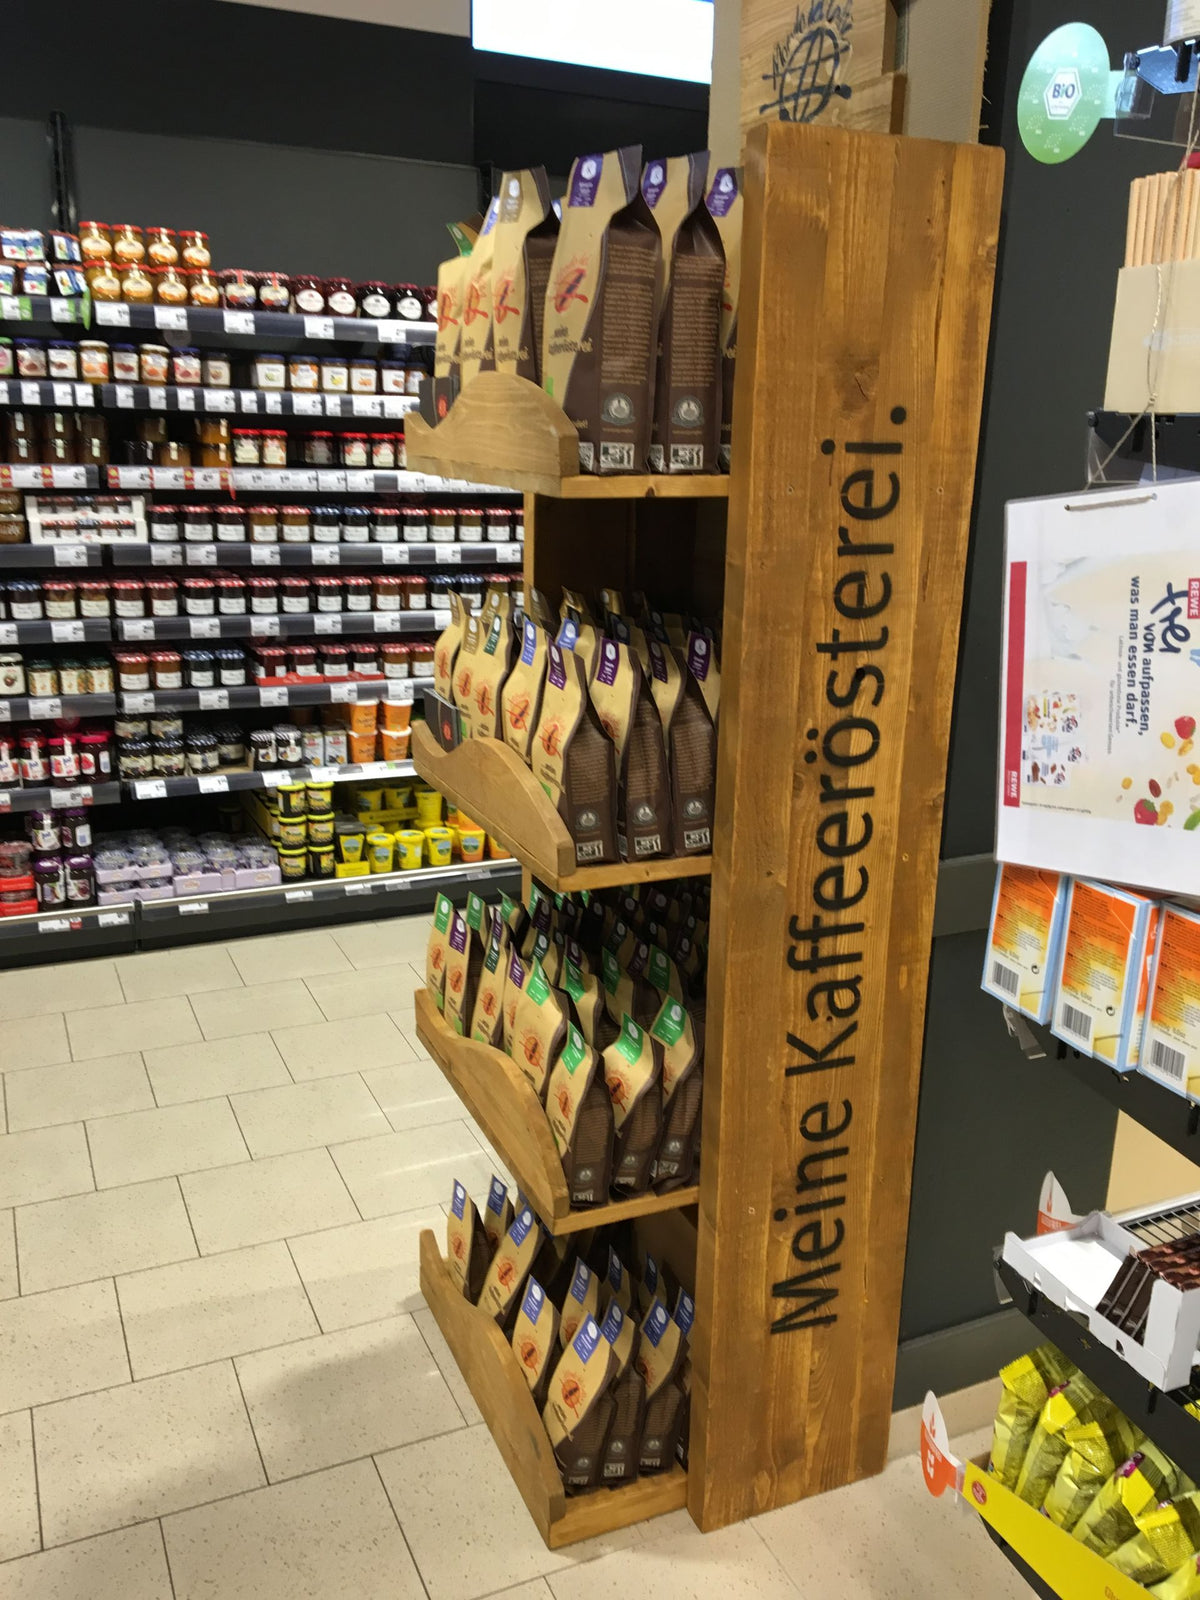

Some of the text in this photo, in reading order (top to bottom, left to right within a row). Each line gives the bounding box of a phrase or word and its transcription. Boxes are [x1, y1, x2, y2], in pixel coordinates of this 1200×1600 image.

[1125, 576, 1140, 729] was man essen darf.
[1189, 581, 1200, 617] REWE
[1137, 623, 1157, 737] von aufpassen,
[1010, 771, 1018, 799] REWE
[771, 405, 907, 1335] Meine Kaffeerösterei.
